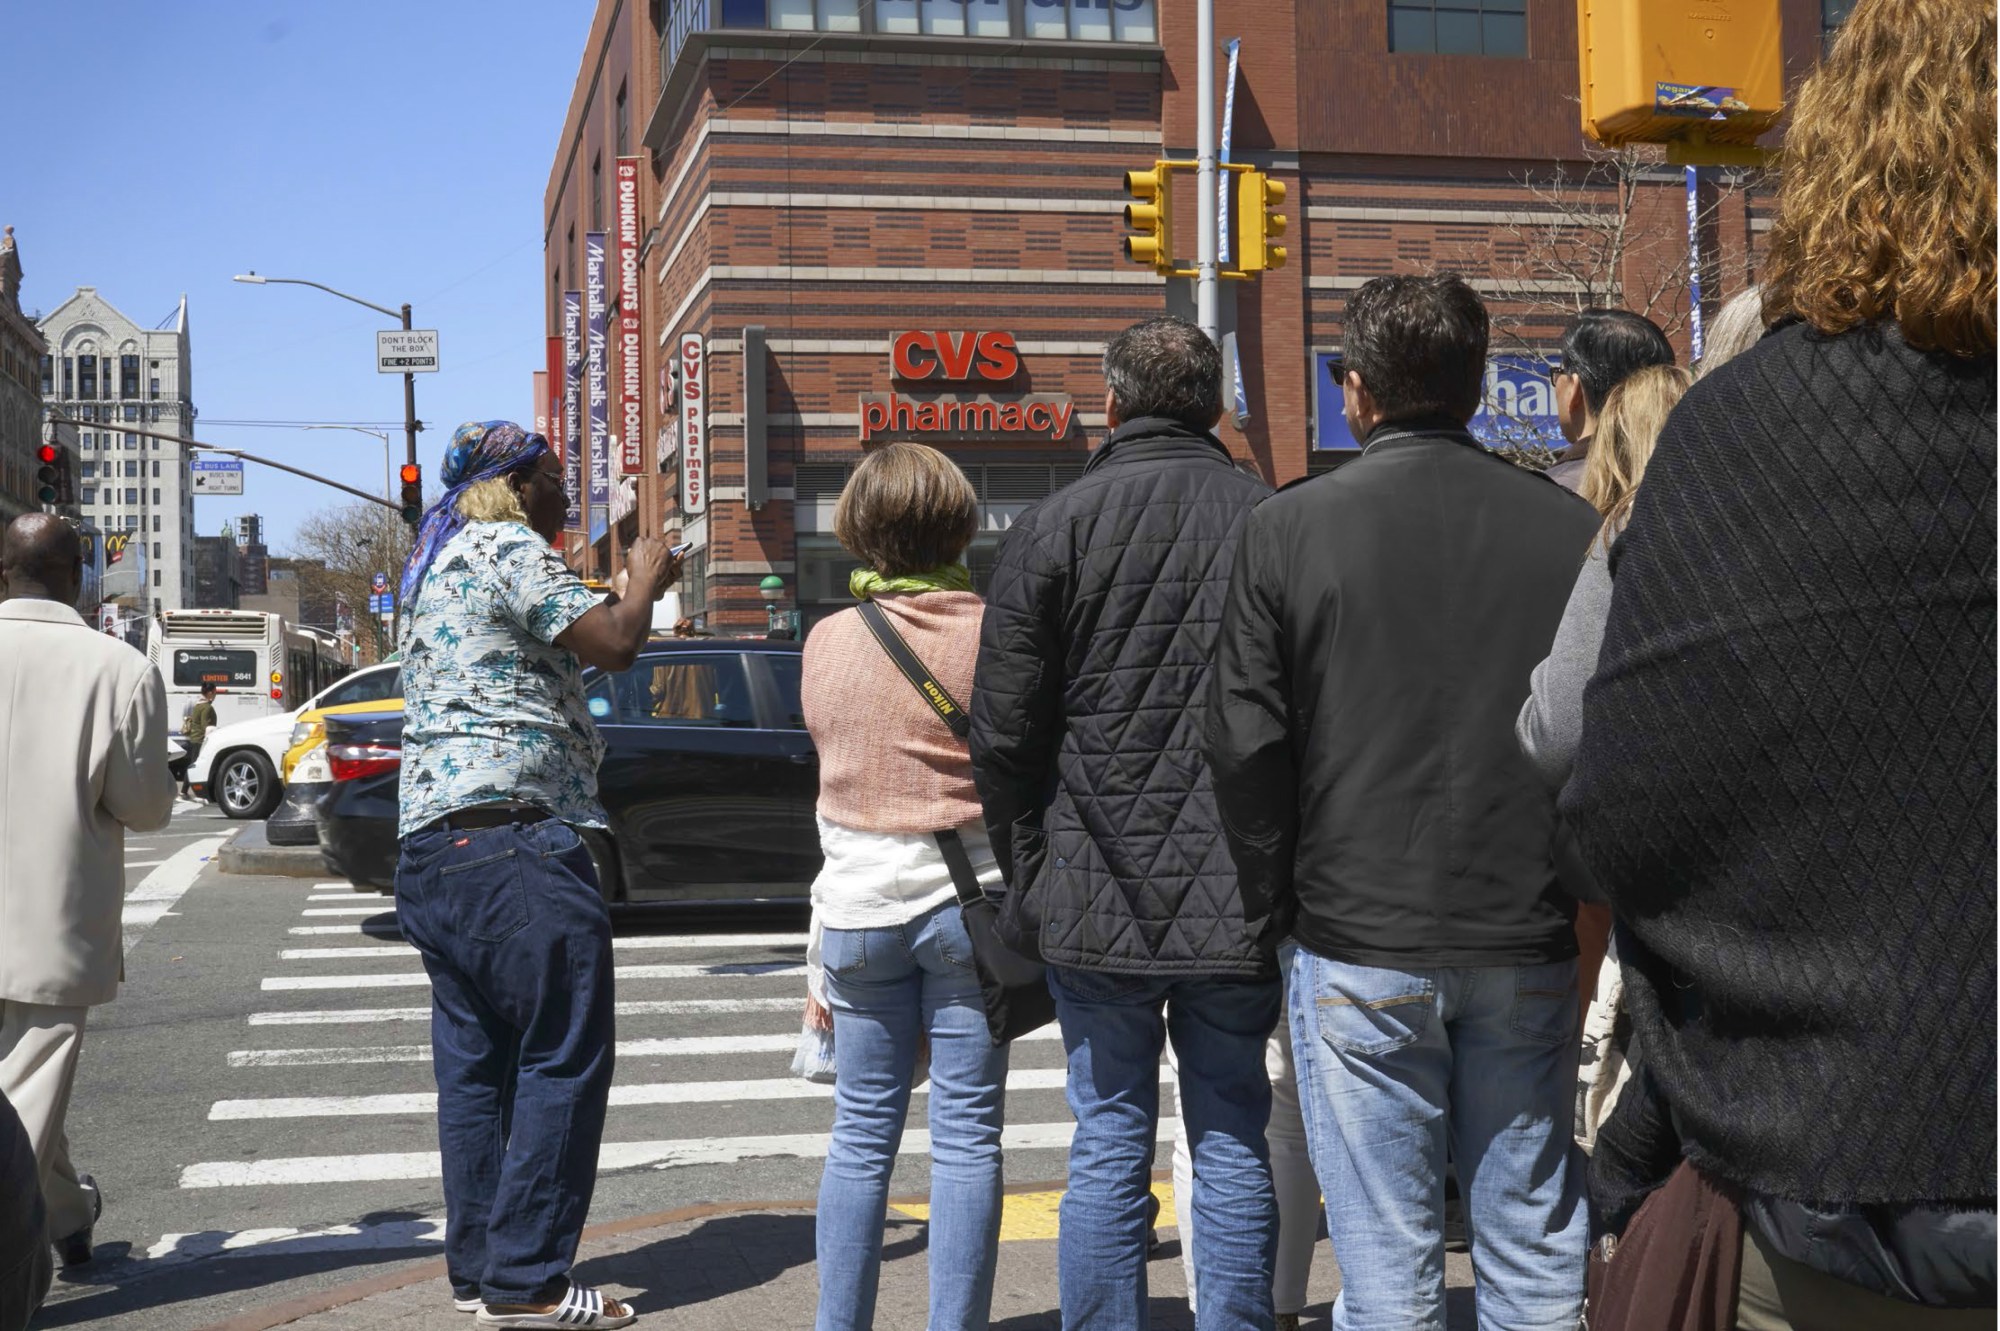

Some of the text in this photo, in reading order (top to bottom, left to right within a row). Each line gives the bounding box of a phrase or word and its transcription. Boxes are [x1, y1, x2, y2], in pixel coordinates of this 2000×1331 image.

[1657, 83, 1692, 93] Vegan
[620, 181, 638, 311] DUNKIN' DONUTS
[587, 241, 605, 320] Marshalls
[381, 336, 433, 344] DON'T BLOCK
[383, 358, 398, 366] FINE
[411, 357, 434, 365] POINTS
[565, 298, 580, 367] Marshalls
[893, 330, 1019, 380] CVS
[589, 327, 606, 407] Marshalls
[624, 333, 640, 466] DUNKIN' DONUTS
[566, 373, 581, 441] Marshalls
[682, 340, 702, 506] CVS pharmacy
[861, 392, 1074, 440] pharmacy
[591, 416, 609, 495] Marshalls
[923, 681, 955, 715] Nikon
